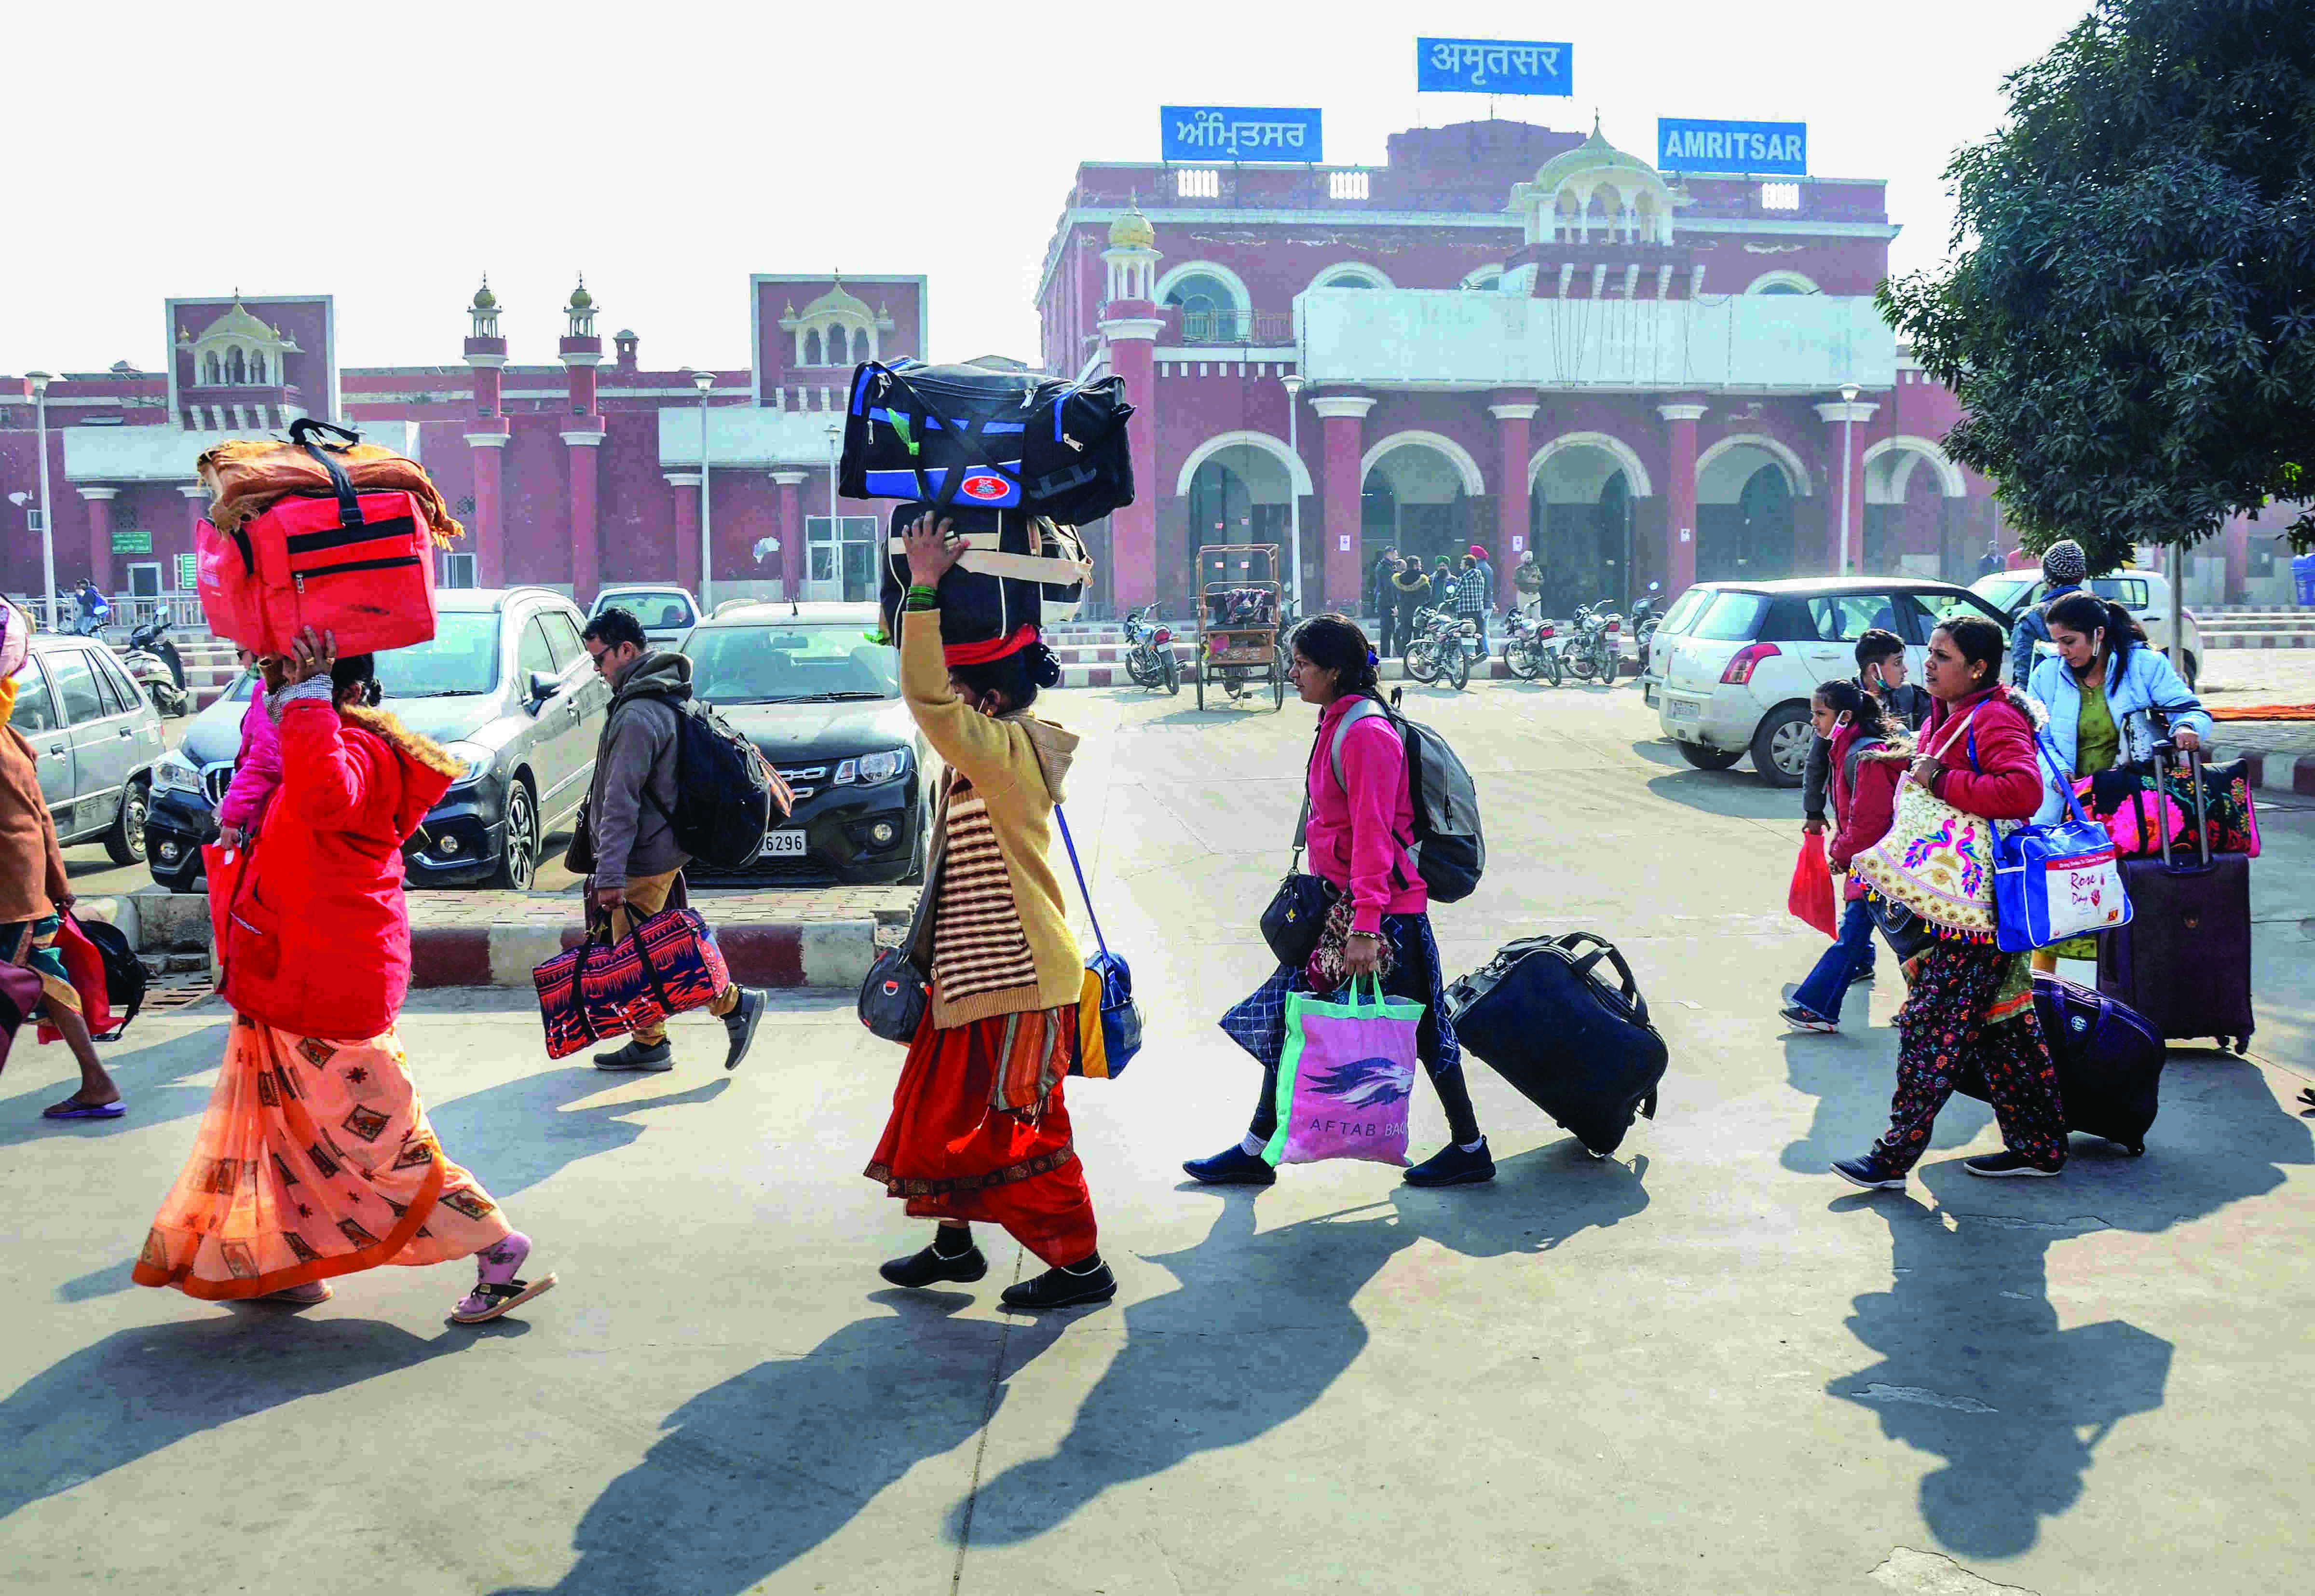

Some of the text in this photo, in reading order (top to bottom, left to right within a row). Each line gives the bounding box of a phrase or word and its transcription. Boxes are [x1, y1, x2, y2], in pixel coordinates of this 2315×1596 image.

[1431, 43, 1560, 85] अमृतसर
[1177, 110, 1307, 156] ਅੰਮ੍ਰਿਤਸਰ
[1665, 130, 1802, 161] AMRITSAR
[762, 835, 802, 851] 6296
[2070, 872, 2096, 890] Rose
[2071, 892, 2088, 906] Day
[1310, 1119, 1376, 1137] AFTAB
